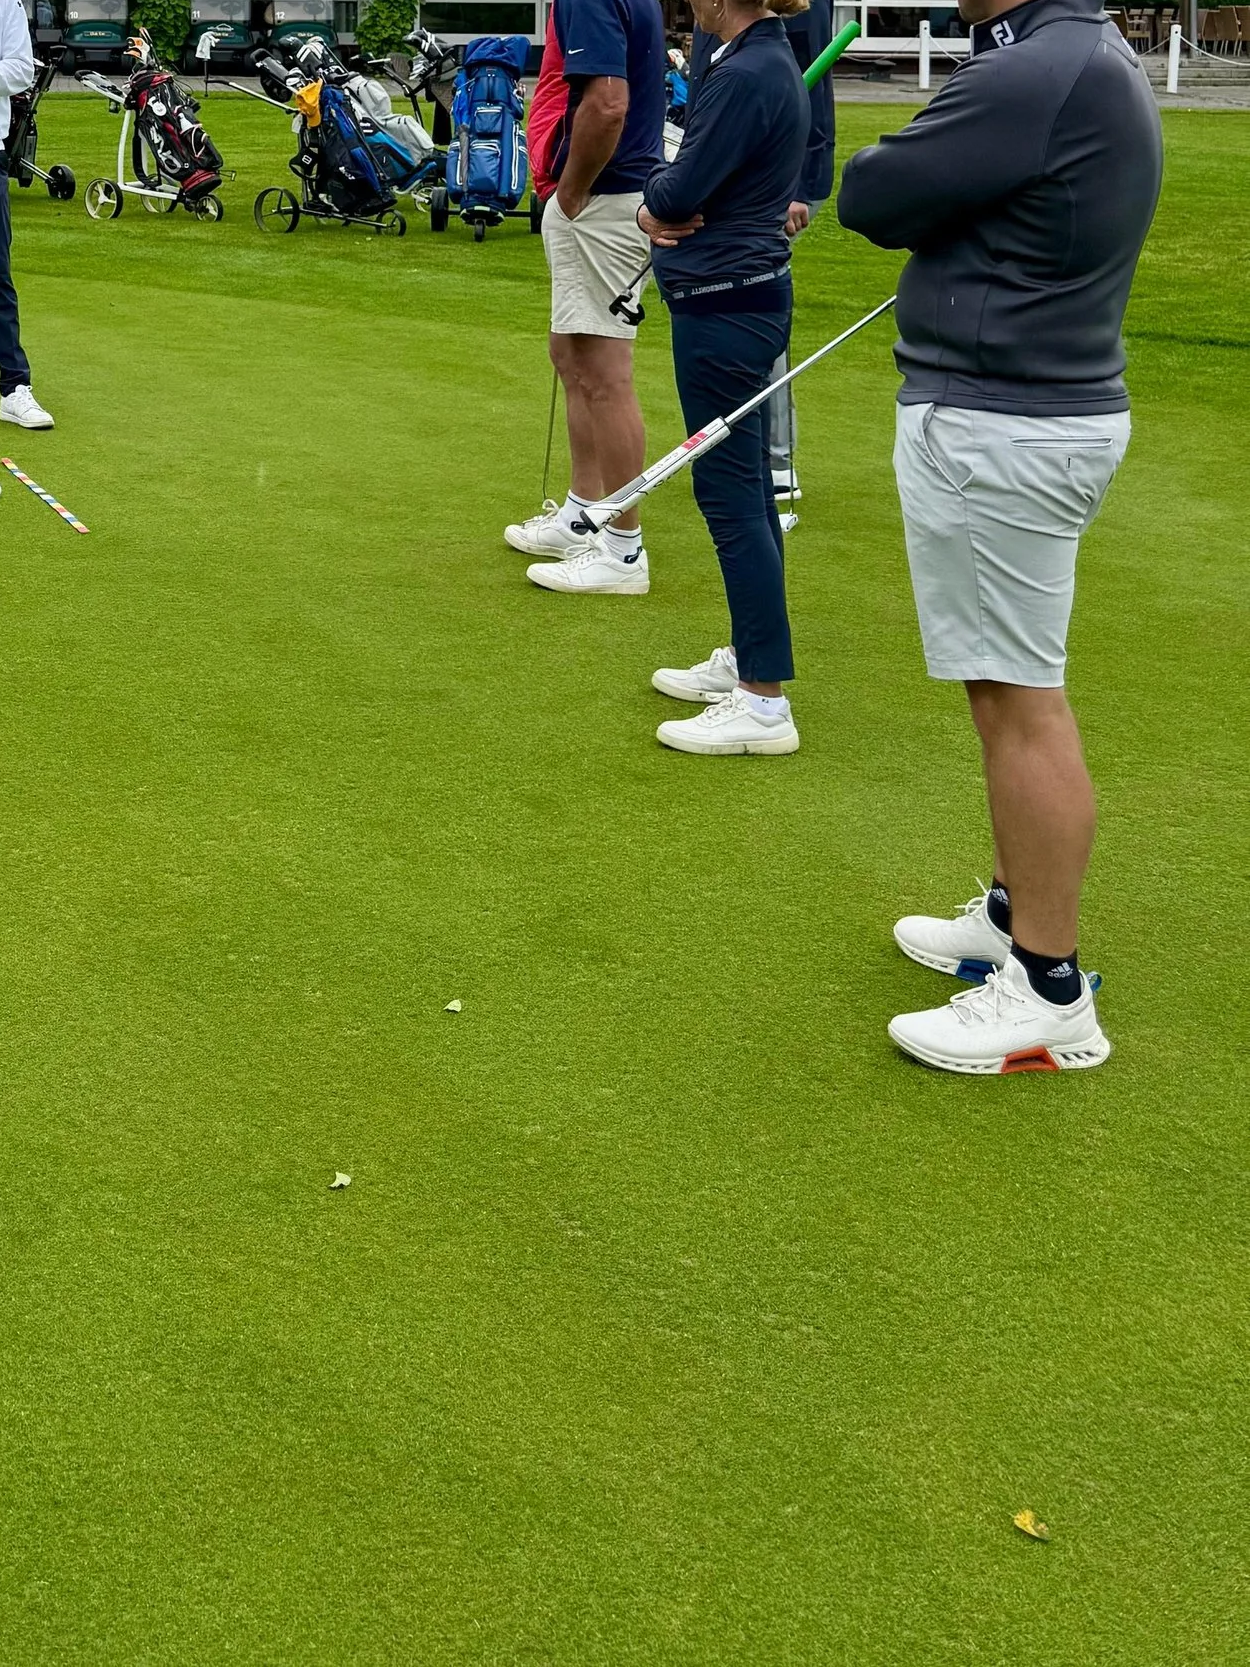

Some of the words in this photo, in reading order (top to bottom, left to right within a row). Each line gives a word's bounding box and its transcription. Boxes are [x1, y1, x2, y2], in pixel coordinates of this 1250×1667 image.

[70, 11, 79, 19] 10
[192, 11, 200, 19] 11
[276, 11, 285, 20] 12
[990, 20, 1015, 47] FJ
